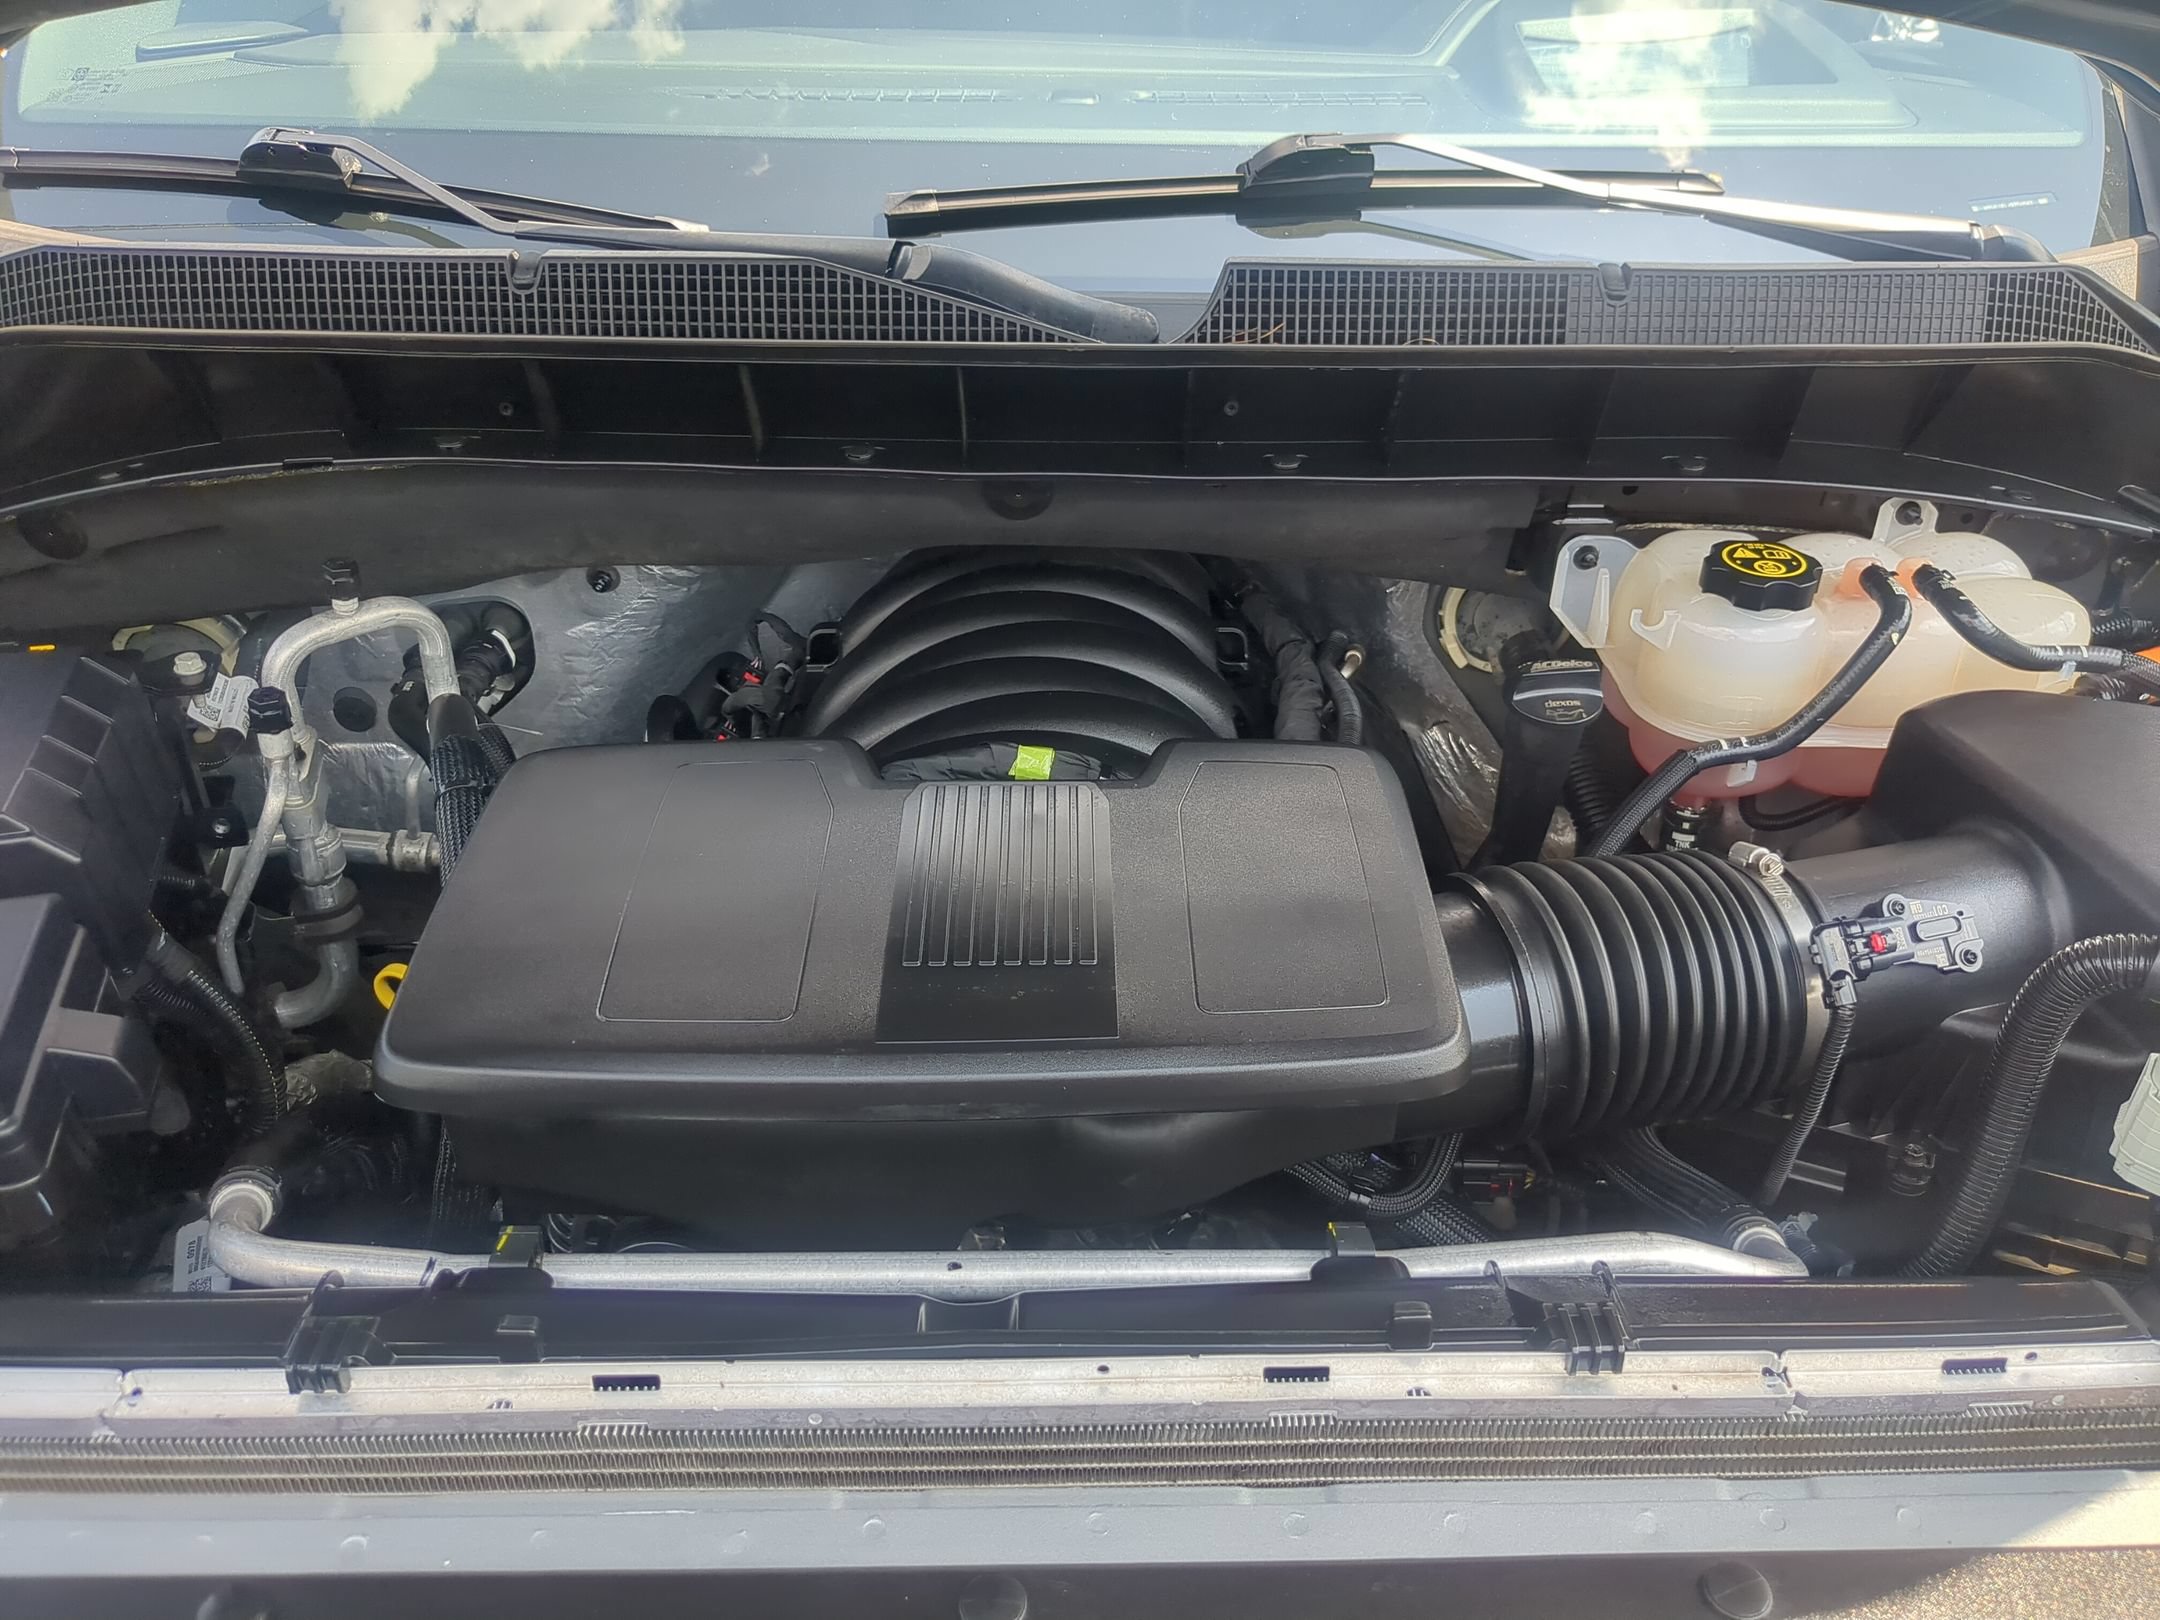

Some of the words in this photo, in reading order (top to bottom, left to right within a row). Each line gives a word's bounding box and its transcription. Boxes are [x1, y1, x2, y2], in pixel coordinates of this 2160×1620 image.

[1530, 660, 1594, 673] ACDelco
[1545, 699, 1581, 708] dexos
[1675, 840, 1691, 849] TNK
